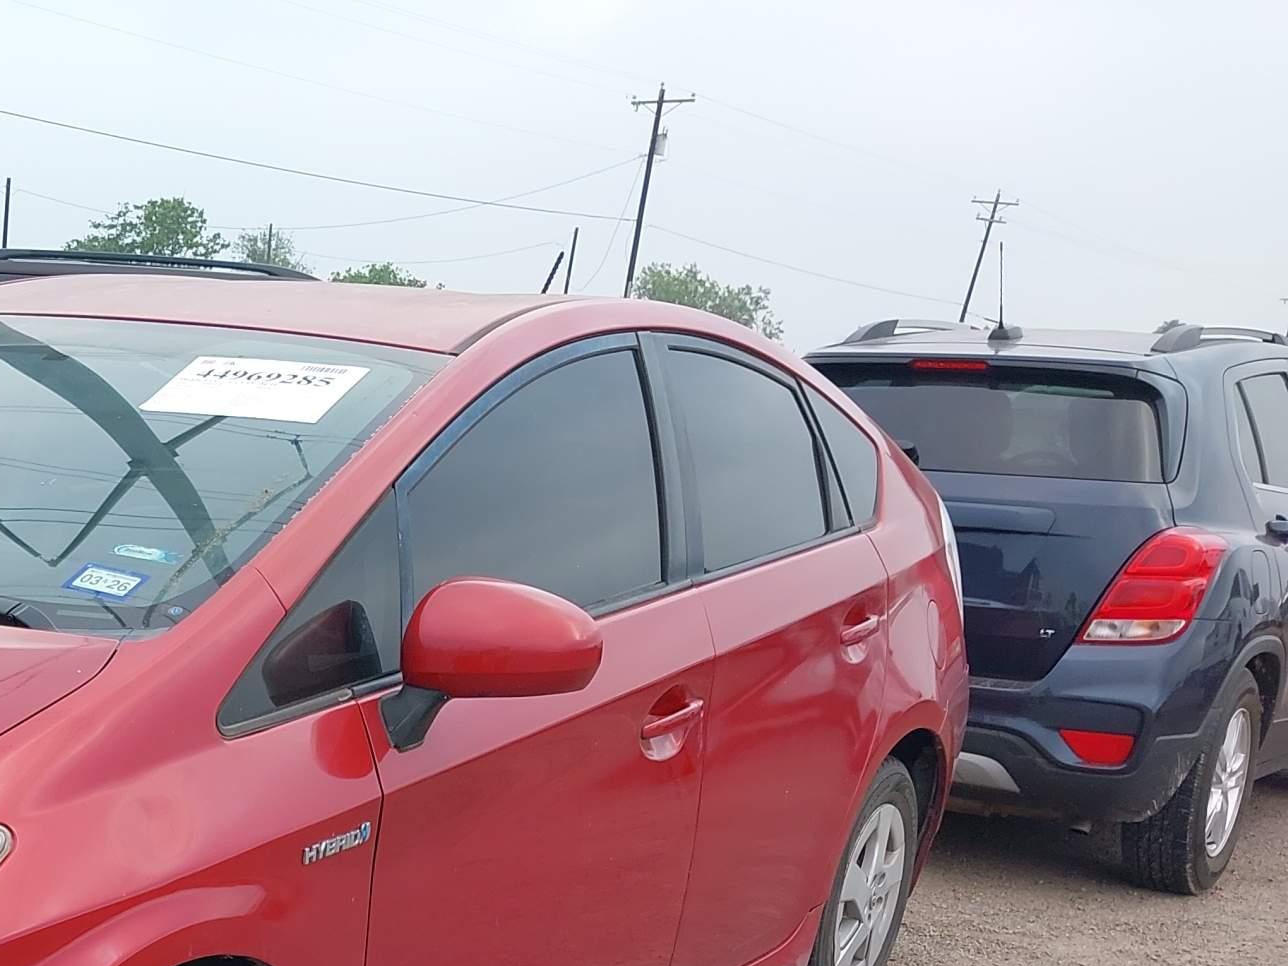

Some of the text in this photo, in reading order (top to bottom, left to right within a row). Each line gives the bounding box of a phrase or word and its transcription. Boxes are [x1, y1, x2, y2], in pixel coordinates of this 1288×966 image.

[196, 368, 336, 387] 44969285
[80, 573, 131, 592] 03 26
[1040, 629, 1055, 639] LT
[303, 829, 362, 864] HYBRID
